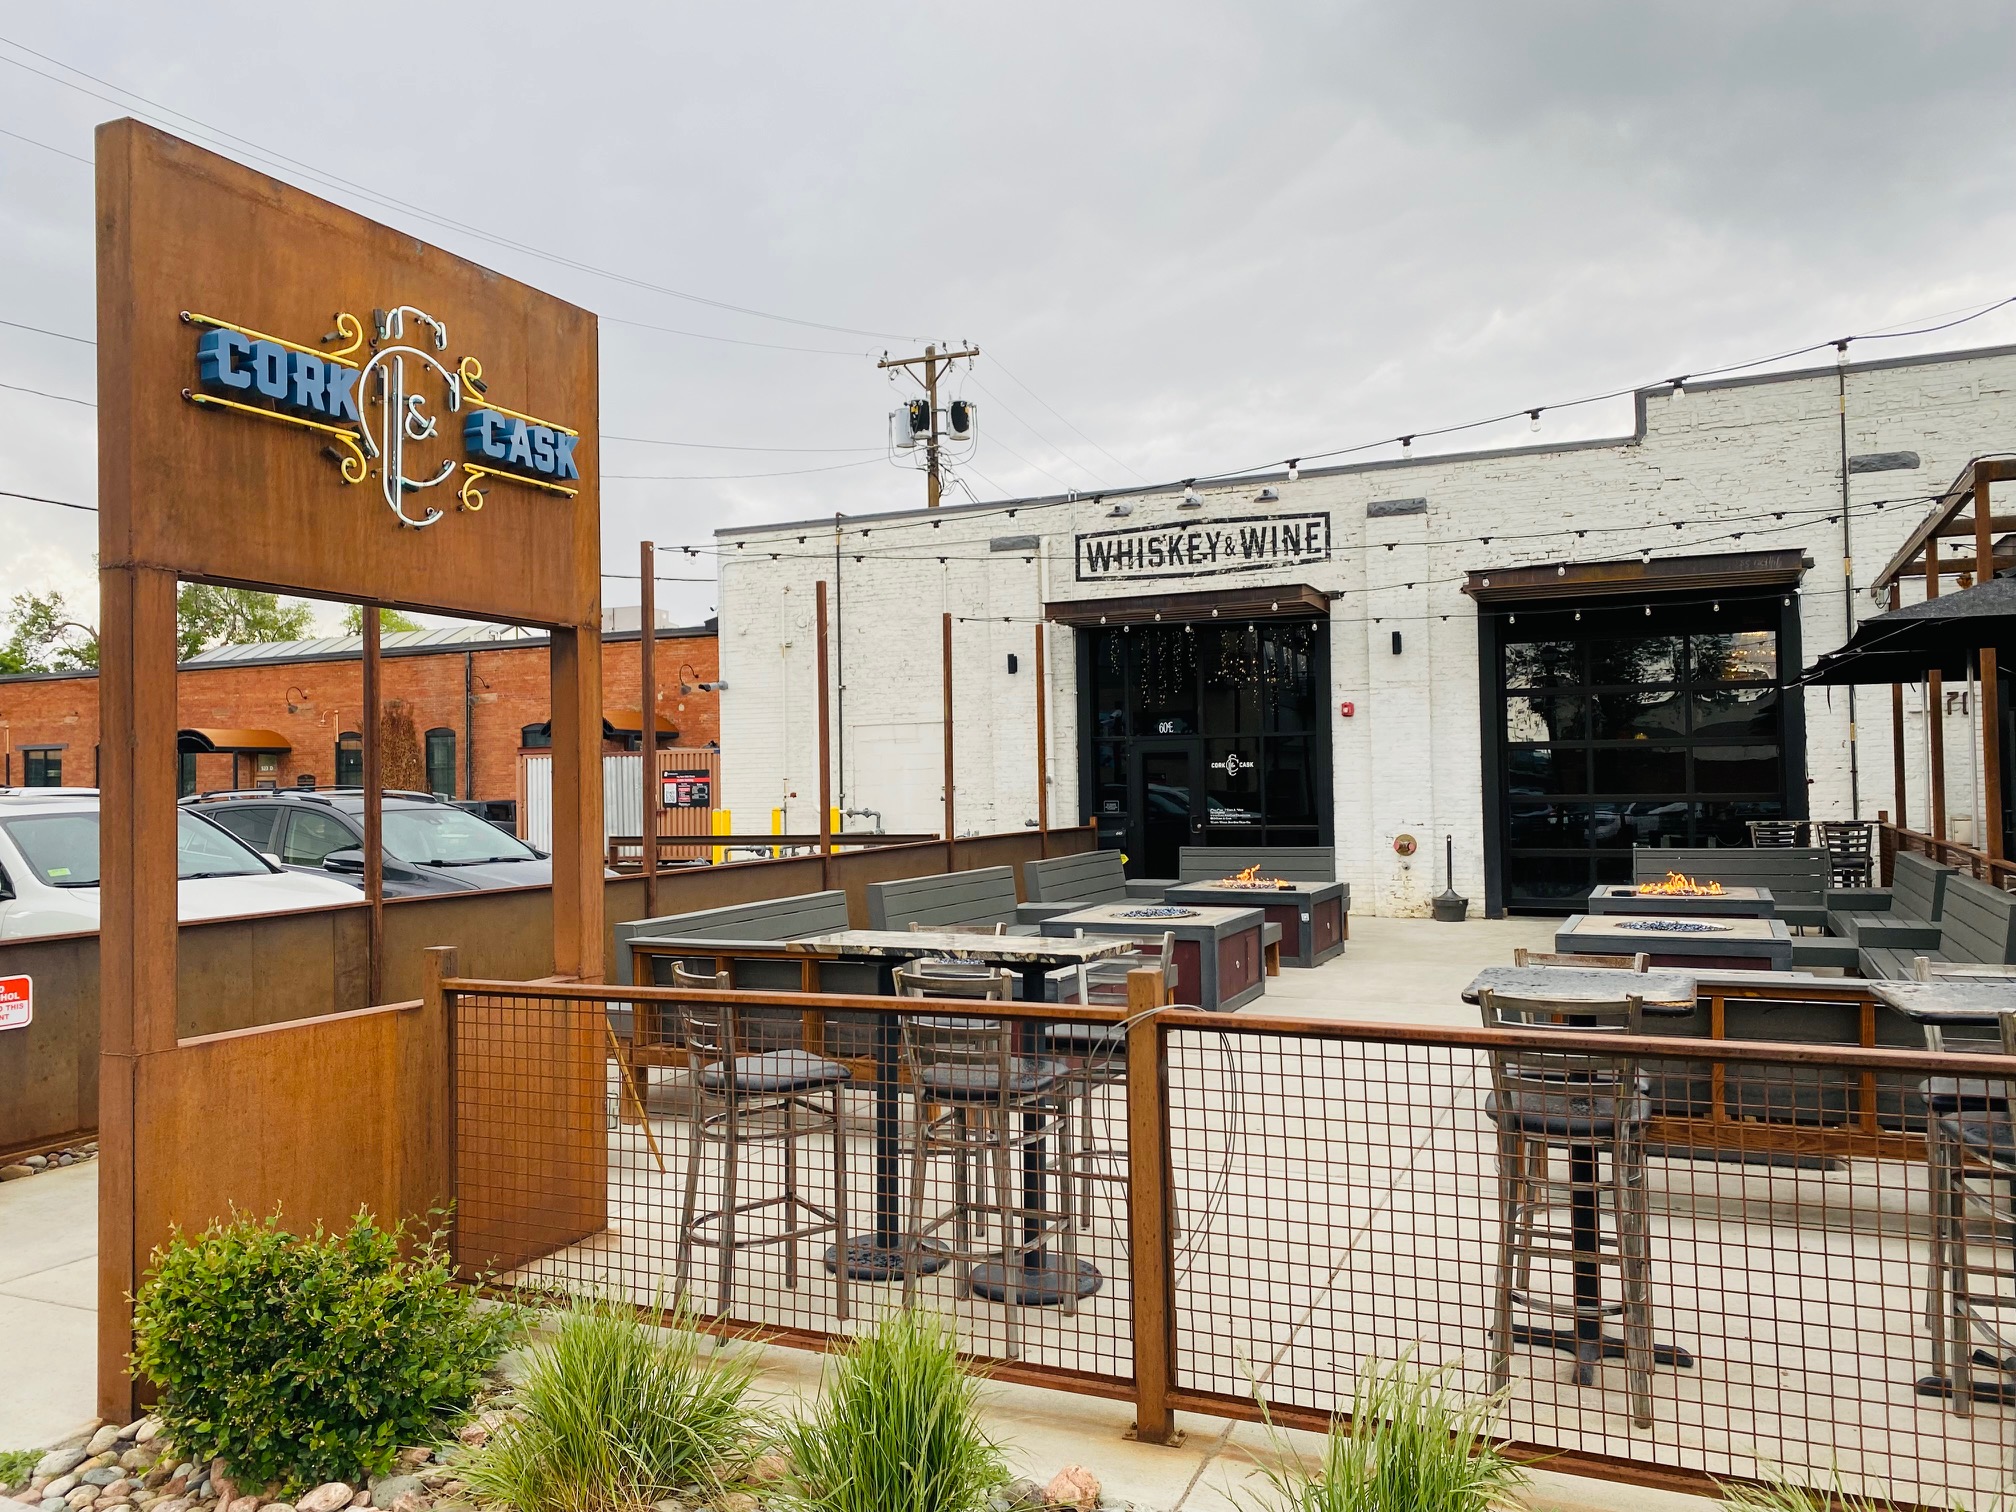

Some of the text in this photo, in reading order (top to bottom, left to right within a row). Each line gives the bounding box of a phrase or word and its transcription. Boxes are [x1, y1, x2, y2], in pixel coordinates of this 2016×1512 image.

[197, 328, 580, 480] CORK & CASK
[1086, 521, 1322, 572] WHISKEY & WINE
[0, 991, 20, 1001] HOL
[6, 1002, 24, 1011] THIS
